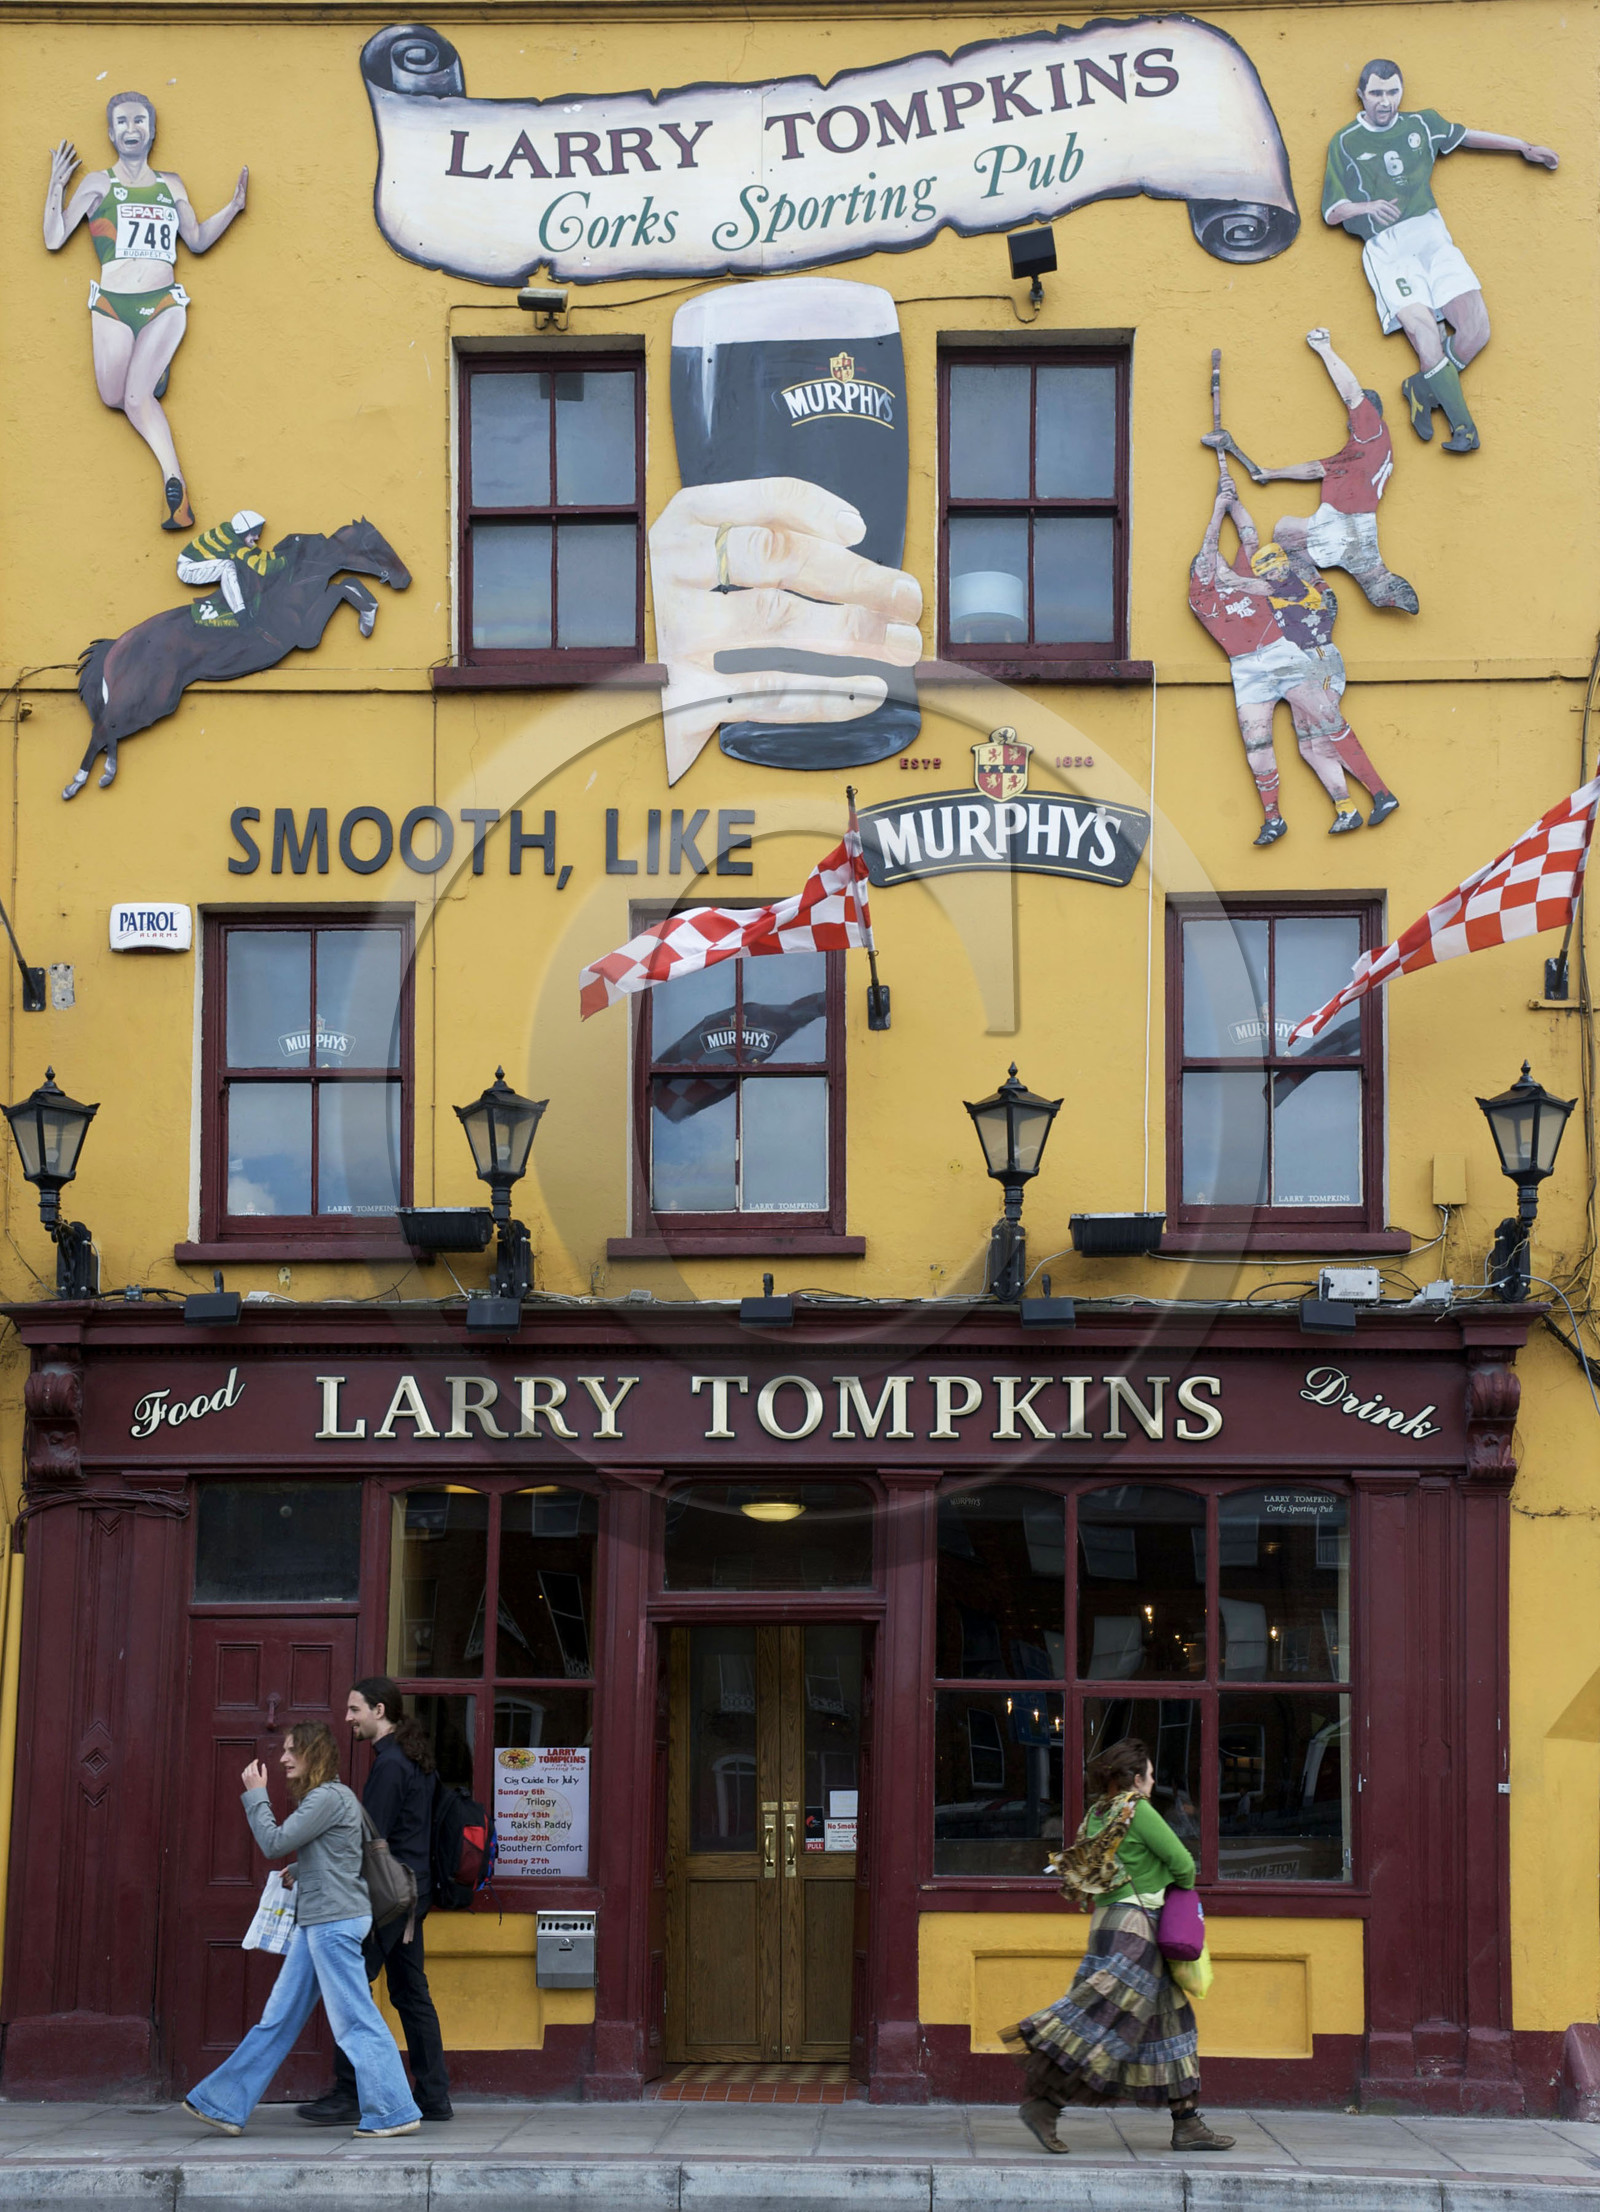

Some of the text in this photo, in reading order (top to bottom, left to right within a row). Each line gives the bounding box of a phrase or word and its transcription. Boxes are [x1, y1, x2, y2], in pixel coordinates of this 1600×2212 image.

[445, 48, 1179, 179] LARRY TOMPKINS
[1384, 150, 1404, 176] 6
[538, 132, 1084, 252] Corks Sporting Pub
[121, 206, 164, 220] SPAR
[128, 221, 171, 250] 748
[1396, 277, 1412, 297] 6
[874, 802, 1122, 869] MURPHY'S
[228, 805, 755, 890] SMOOTH, LIKE
[120, 911, 178, 932] PATROL
[1308, 1194, 1350, 1202] TOMPKINS
[130, 1366, 245, 1438] Food
[1300, 1366, 1441, 1439] Drink
[315, 1375, 1224, 1441] LARRY TOMPKINS
[1294, 1495, 1336, 1503] TOMPKINS
[1266, 1504, 1334, 1514] Corks Sporting Pub
[547, 1748, 577, 1756] LARRY
[538, 1755, 586, 1764] TOMPKINS
[562, 1775, 579, 1785] July
[497, 1788, 545, 1796] Sunday 6th
[526, 1798, 557, 1807] Trilogy
[497, 1811, 550, 1819] Sunday 13th
[511, 1821, 572, 1831] Rakish Paddy
[497, 1834, 550, 1842] Sunday 20th
[500, 1844, 583, 1852] Southern Comfort
[497, 1857, 550, 1865] Sunday 27th
[521, 1867, 562, 1875] Freedom
